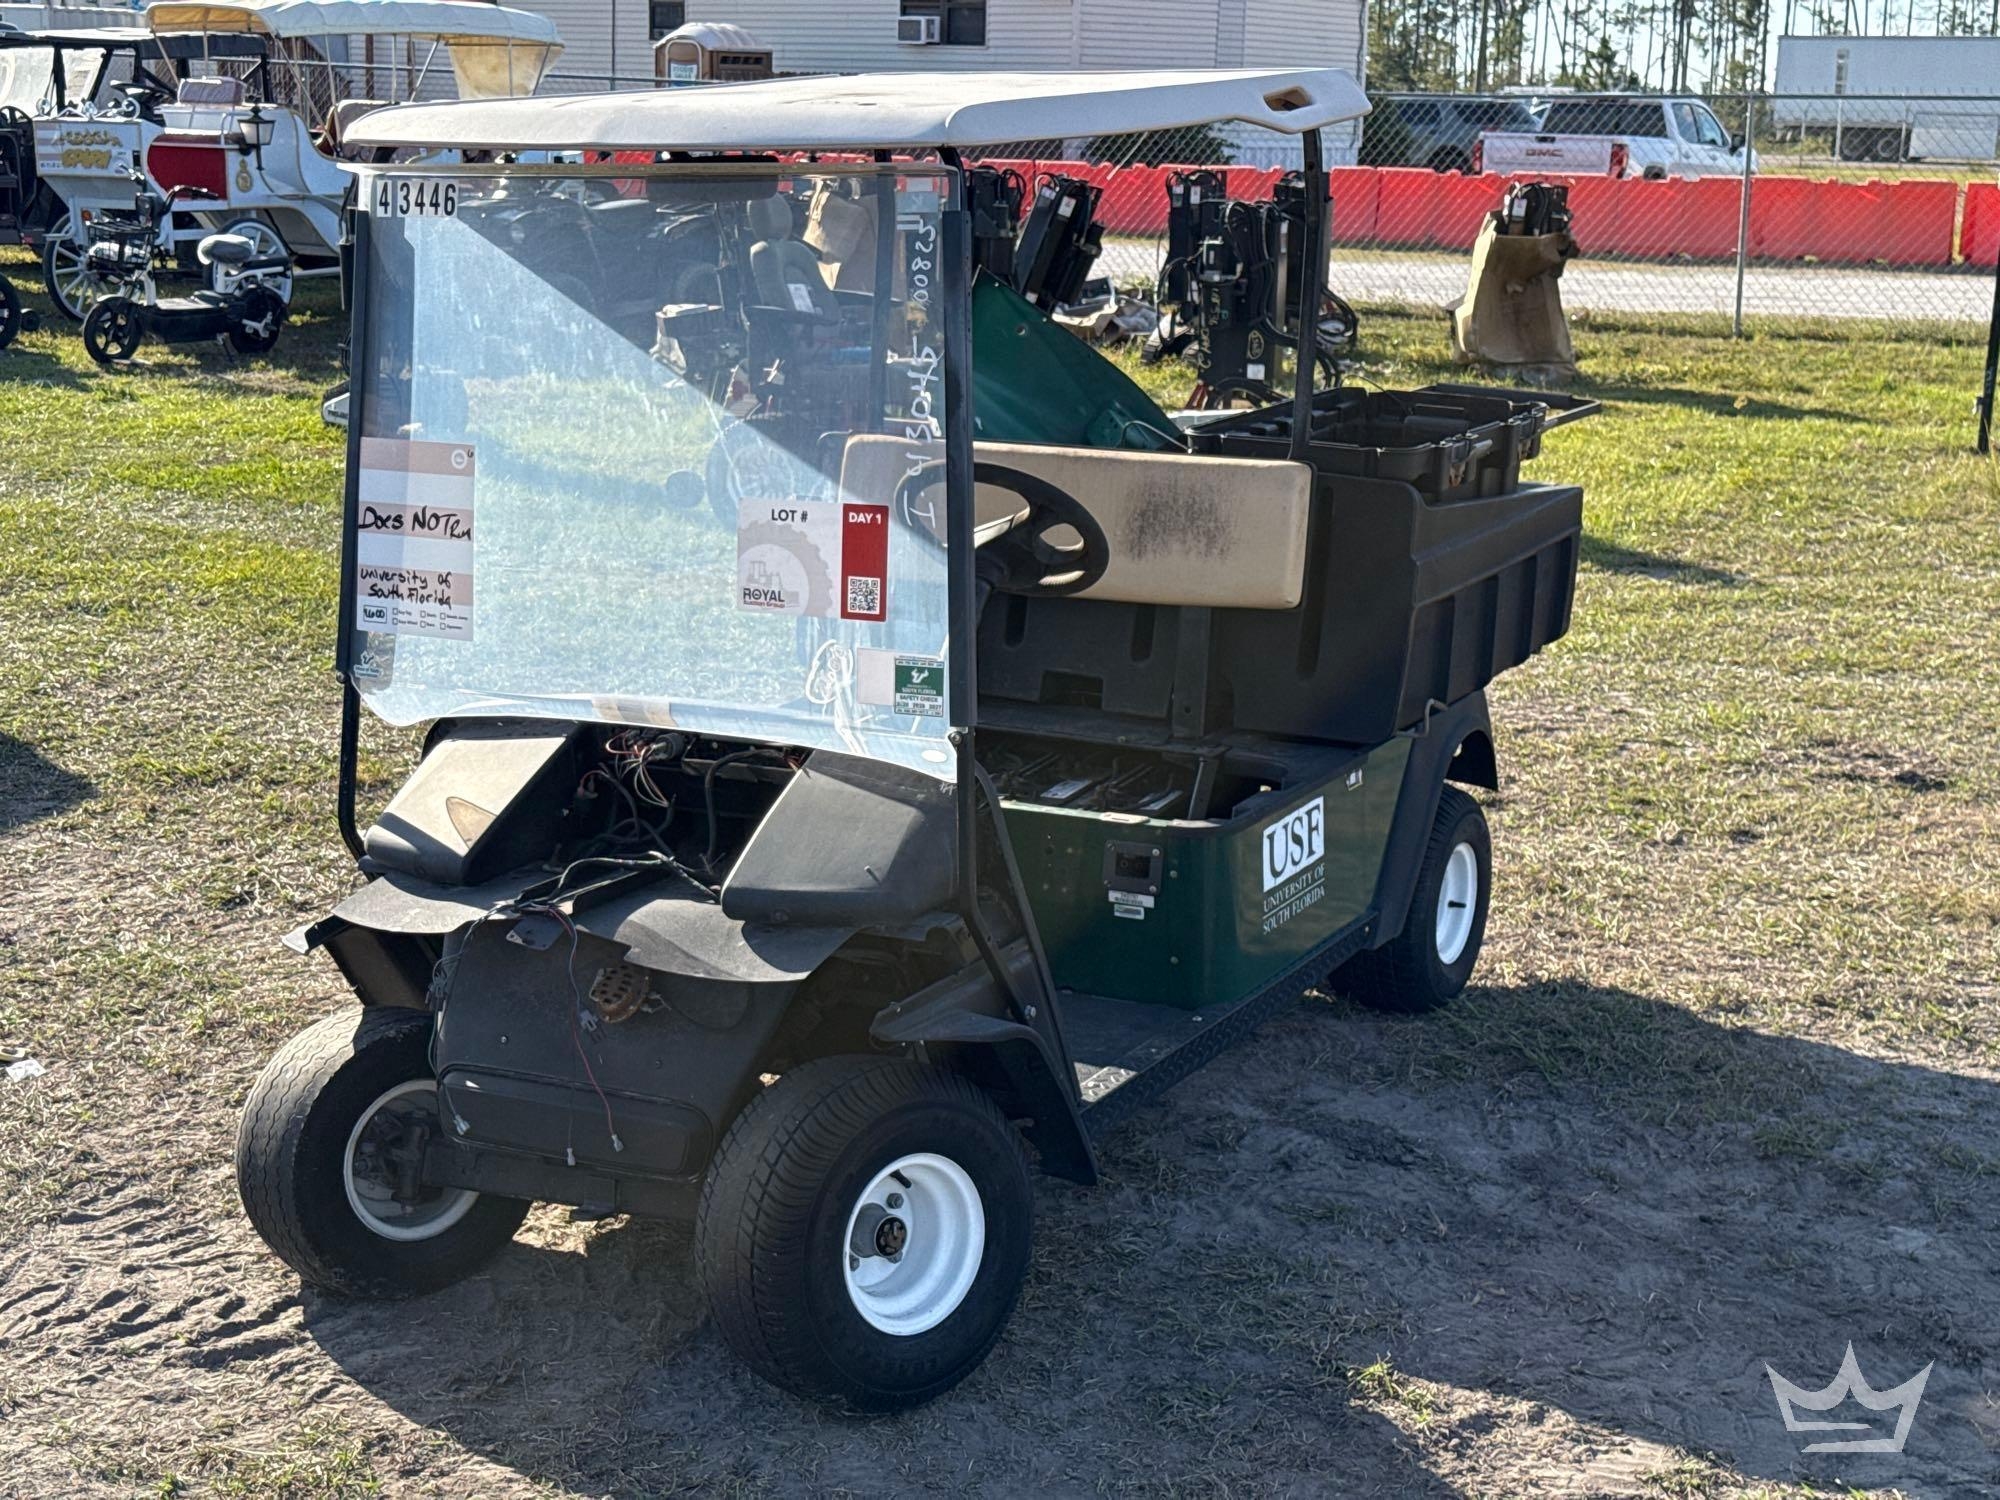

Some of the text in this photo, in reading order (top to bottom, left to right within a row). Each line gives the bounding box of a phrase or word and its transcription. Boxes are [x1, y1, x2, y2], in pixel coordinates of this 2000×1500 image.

[1526, 149, 1563, 157] GMC
[379, 182, 457, 216] 43446
[358, 506, 404, 530] Does
[412, 505, 457, 536] NOT
[771, 508, 808, 523] LOT #
[848, 511, 882, 525] DAY 1
[437, 571, 452, 589] of
[368, 582, 452, 611] South Florida
[743, 587, 785, 603] ROYAL
[1266, 803, 1320, 879] USF
[1263, 862, 1325, 912] UNIVERSITY OF
[1263, 885, 1325, 936] SOUTH FLORIDA
